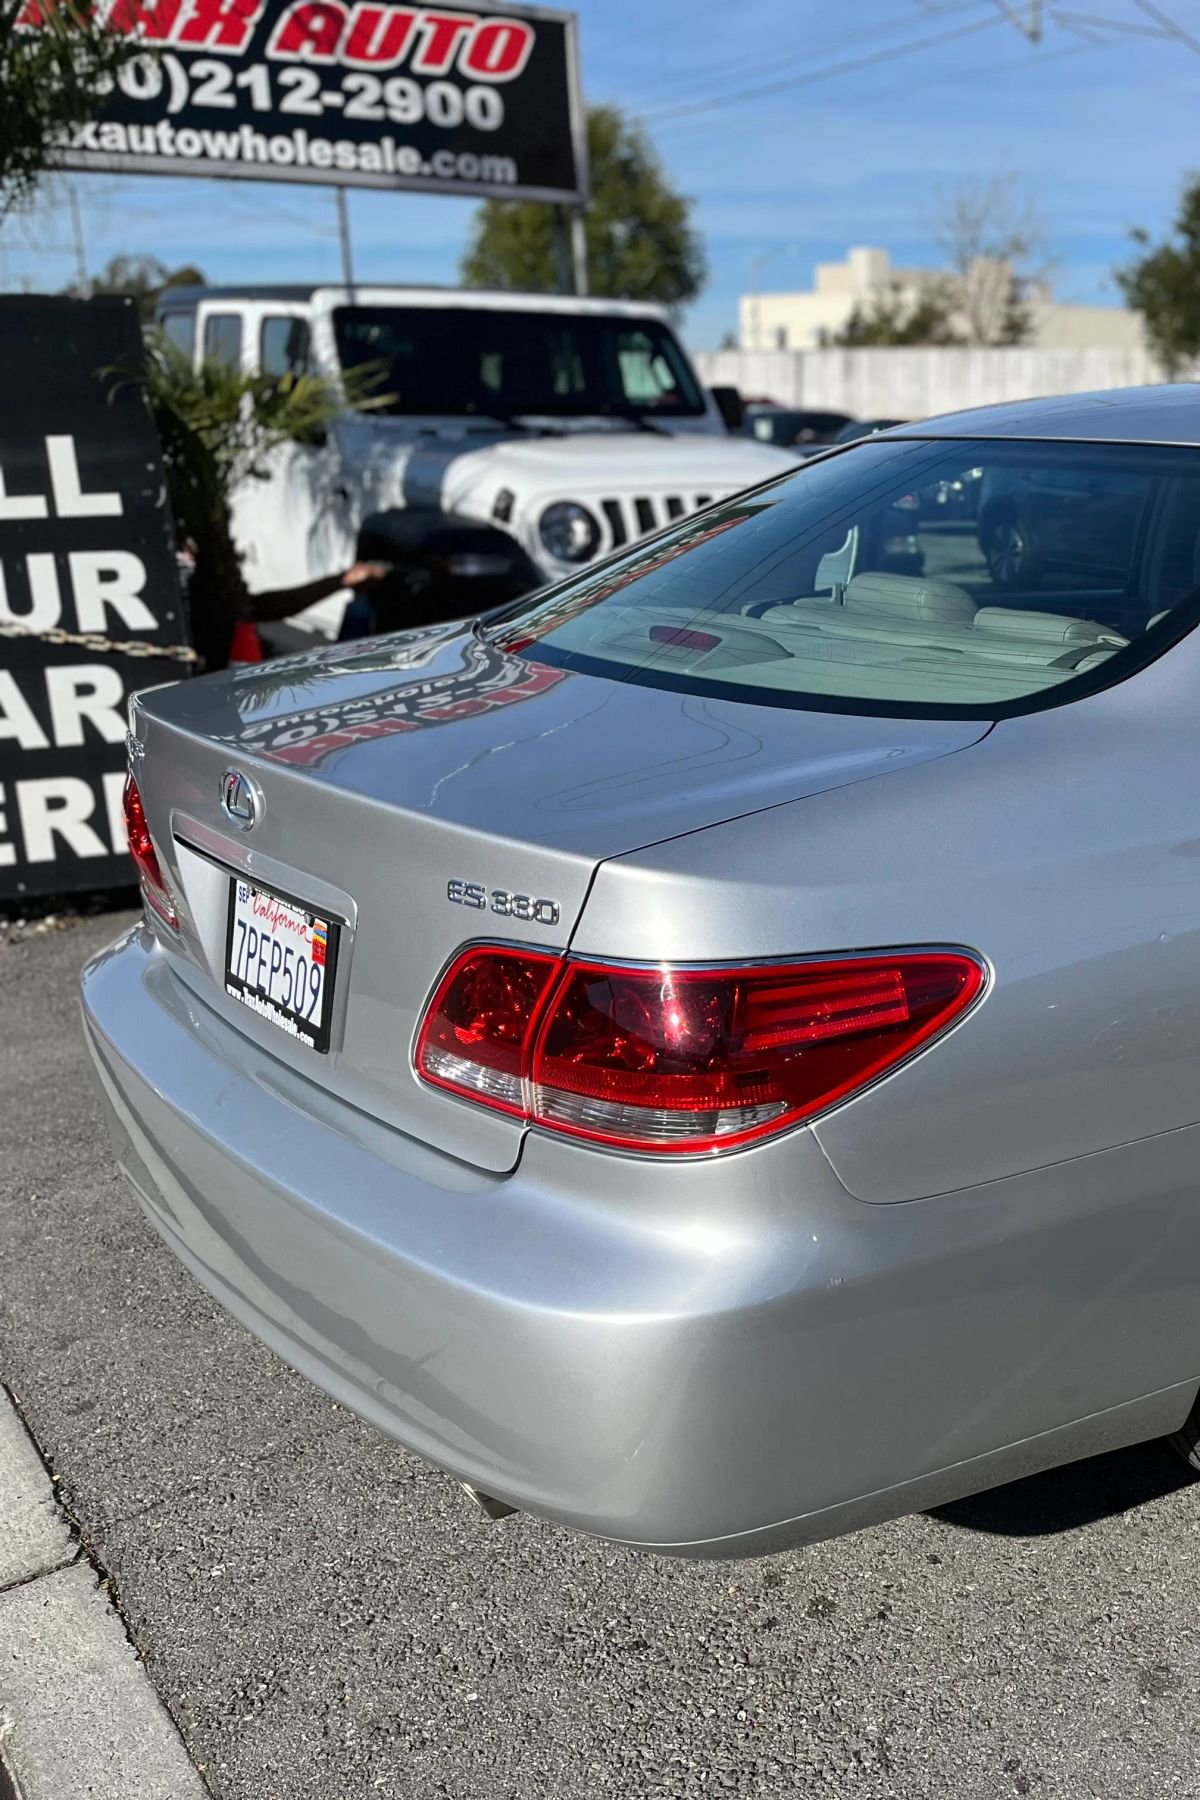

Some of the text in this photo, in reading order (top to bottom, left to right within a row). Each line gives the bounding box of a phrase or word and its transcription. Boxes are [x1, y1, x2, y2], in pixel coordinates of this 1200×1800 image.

[266, 0, 535, 83] AUTO
[88, 53, 505, 131] 0)212-2900
[253, 891, 314, 944] California
[447, 877, 561, 926] ES 330
[236, 918, 321, 1020] 7PEP509
